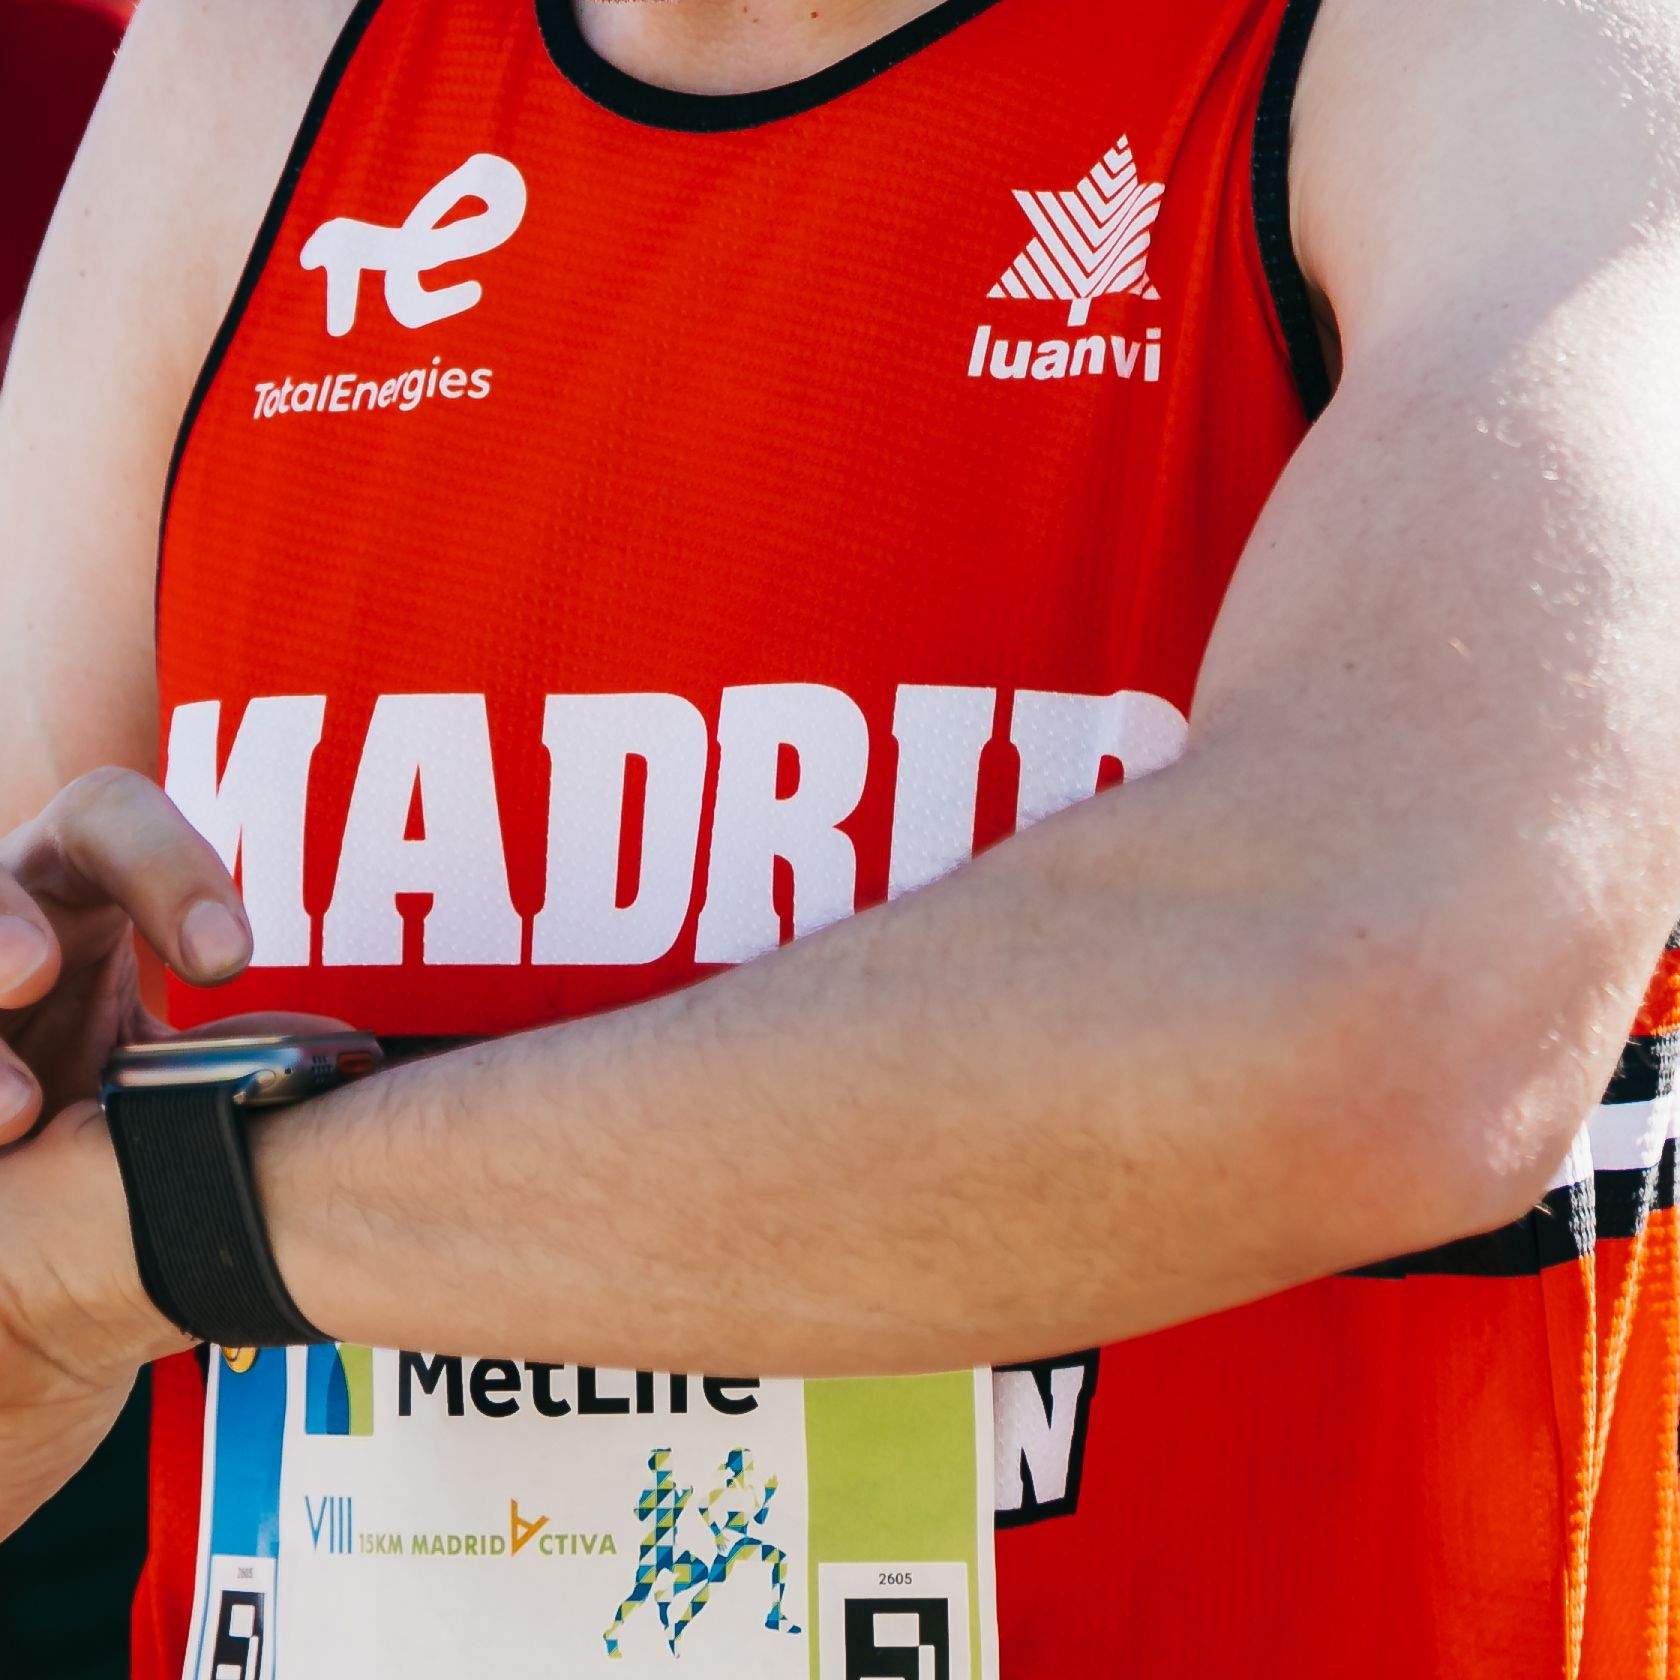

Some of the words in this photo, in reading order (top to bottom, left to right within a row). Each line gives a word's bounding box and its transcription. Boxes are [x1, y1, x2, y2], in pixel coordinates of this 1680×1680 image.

[253, 355, 493, 420] TotalEnergies
[304, 1494, 352, 1553] VIII
[359, 1533, 403, 1555] 15KM
[411, 1534, 505, 1556] MADRID
[878, 1572, 913, 1586] 2605
